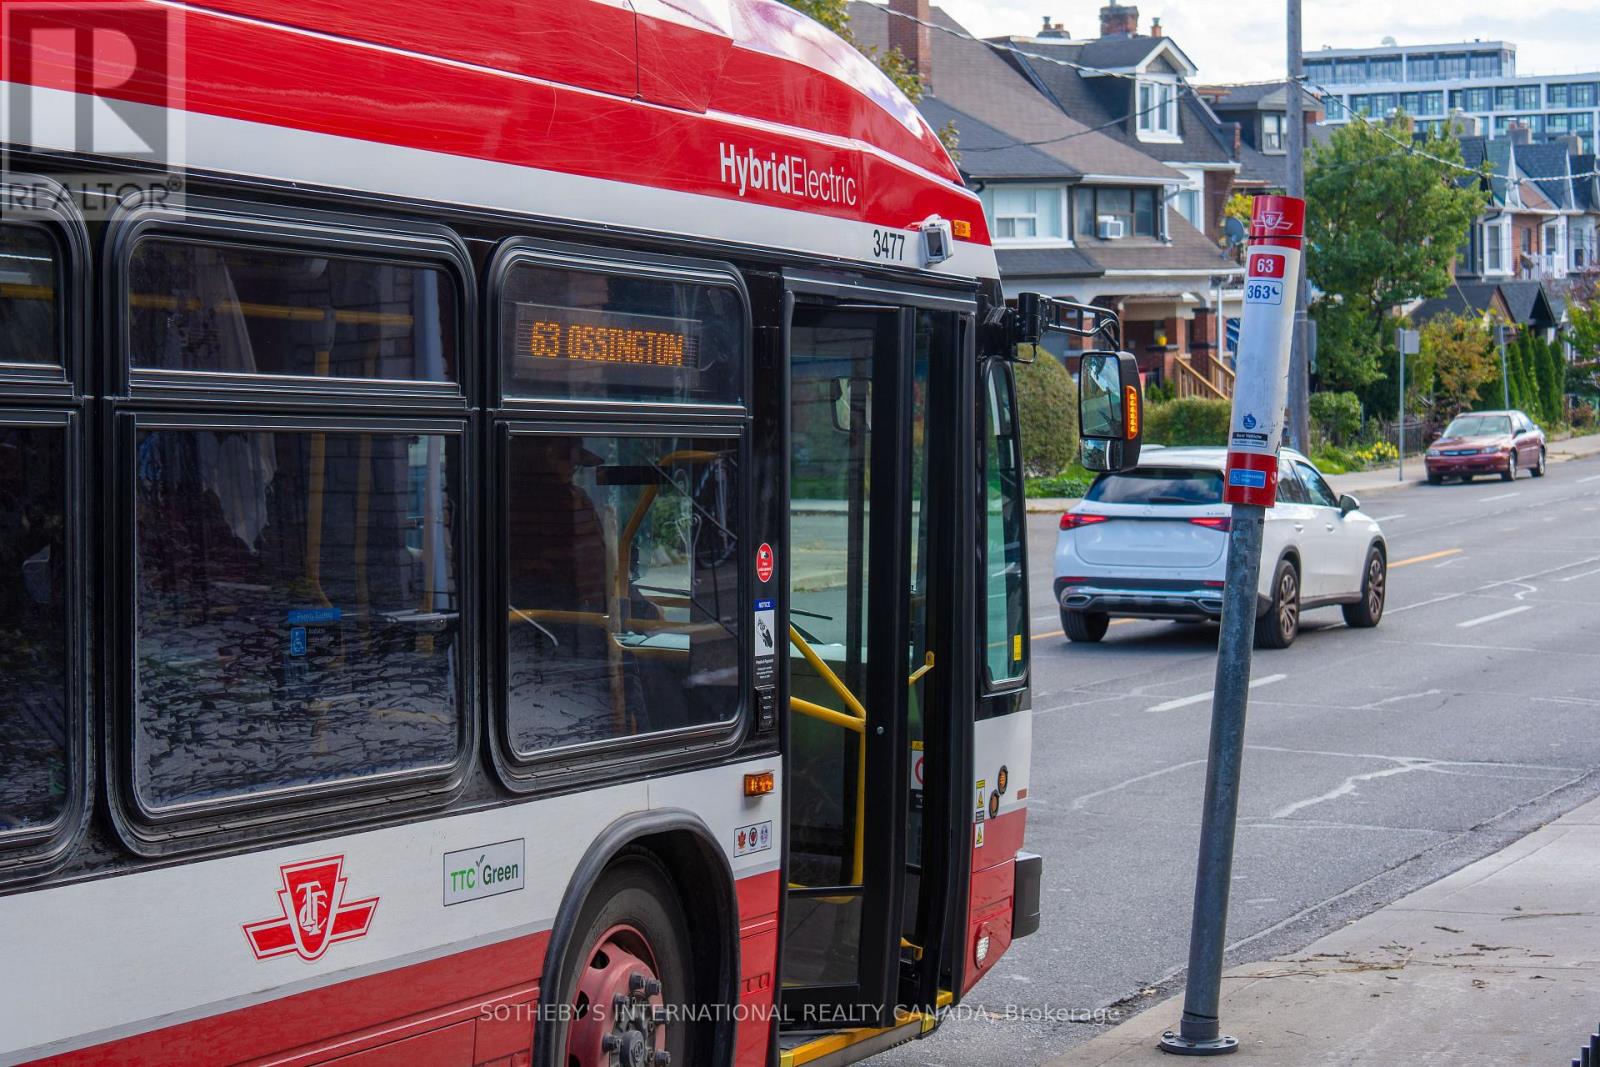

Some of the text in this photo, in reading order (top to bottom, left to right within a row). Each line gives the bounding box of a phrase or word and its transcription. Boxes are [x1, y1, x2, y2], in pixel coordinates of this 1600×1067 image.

[873, 229, 905, 261] 3477
[1257, 258, 1274, 273] 63
[1247, 285, 1271, 299] 363
[531, 321, 684, 368] 63 OSSINGTON
[450, 863, 518, 892] TTC Green
